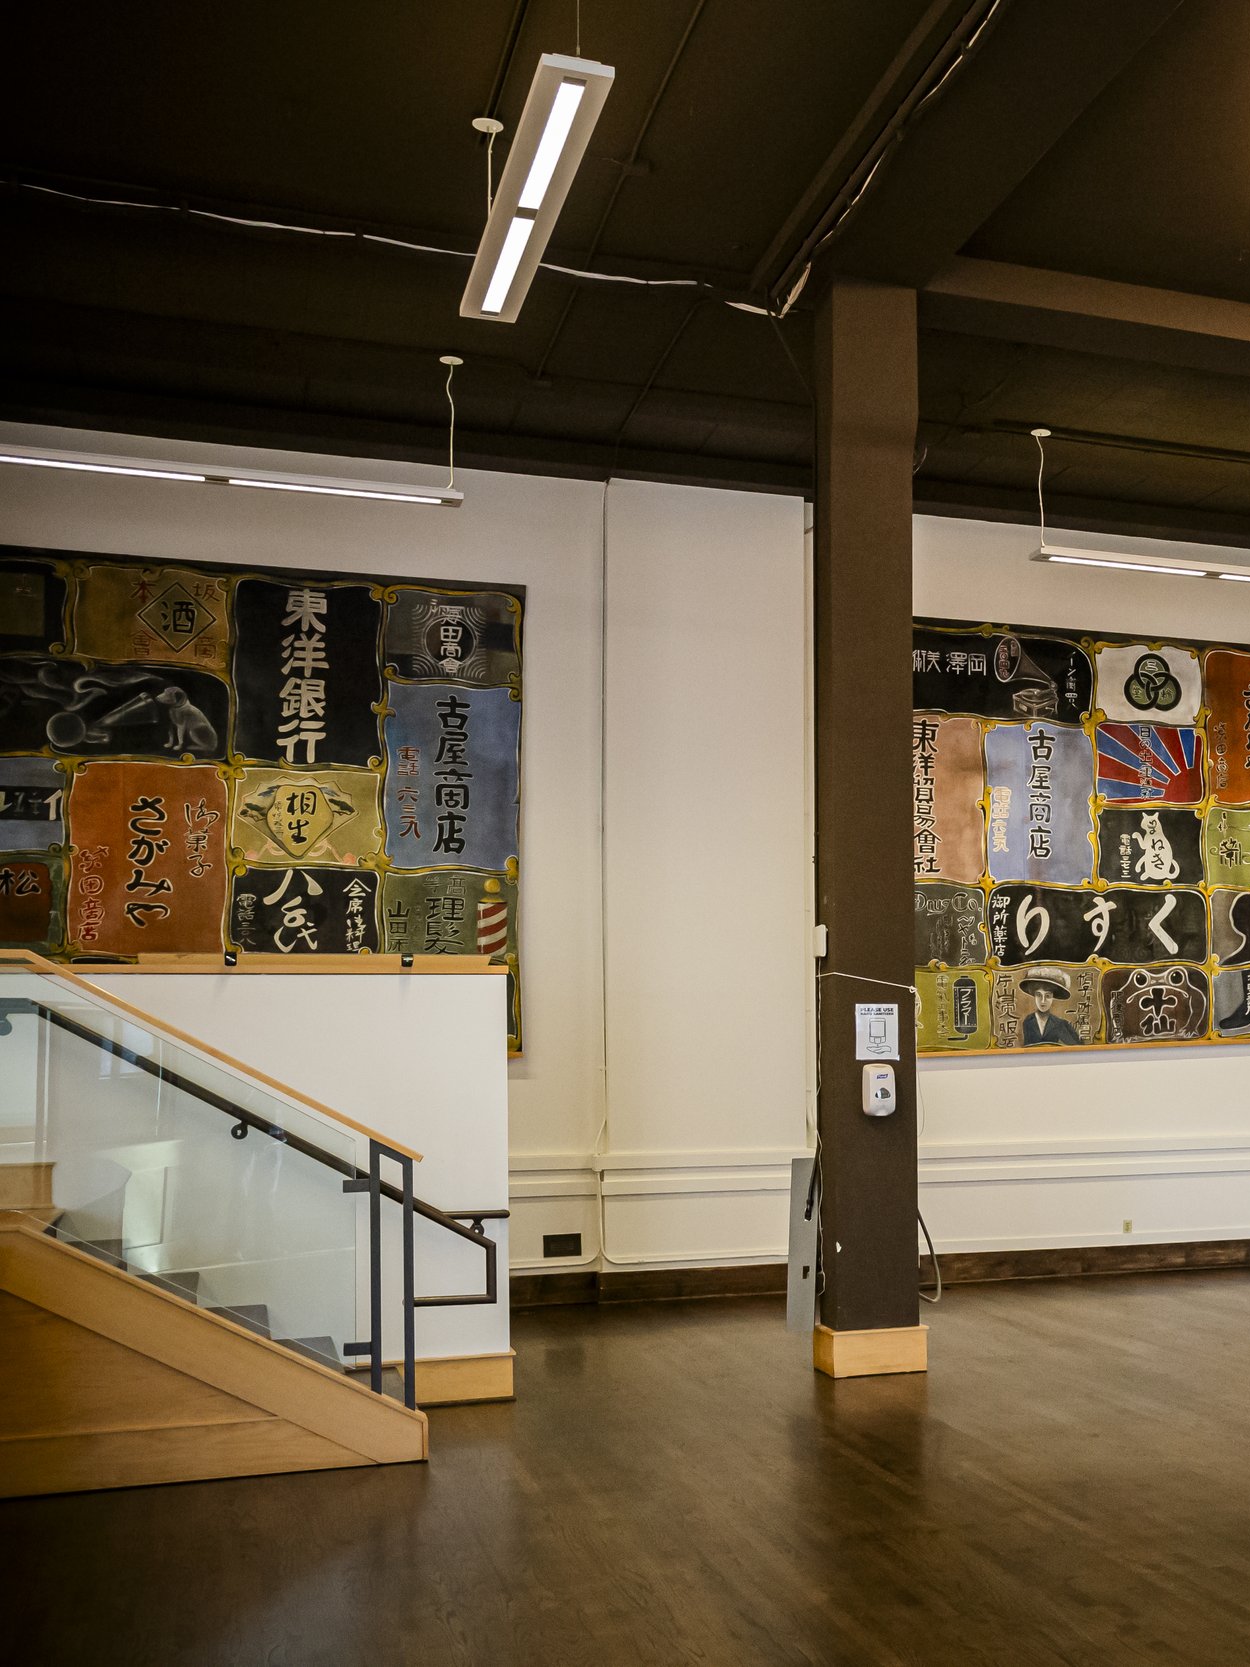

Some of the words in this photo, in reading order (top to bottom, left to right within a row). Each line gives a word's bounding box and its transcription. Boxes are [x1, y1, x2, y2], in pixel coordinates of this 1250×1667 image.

[160, 600, 197, 634] 酒
[276, 588, 330, 764] 東洋銀行
[432, 694, 474, 855] 古屋商店
[1027, 729, 1056, 859] 古屋商店
[125, 795, 174, 929] さがみや
[951, 891, 982, 913] Co.
